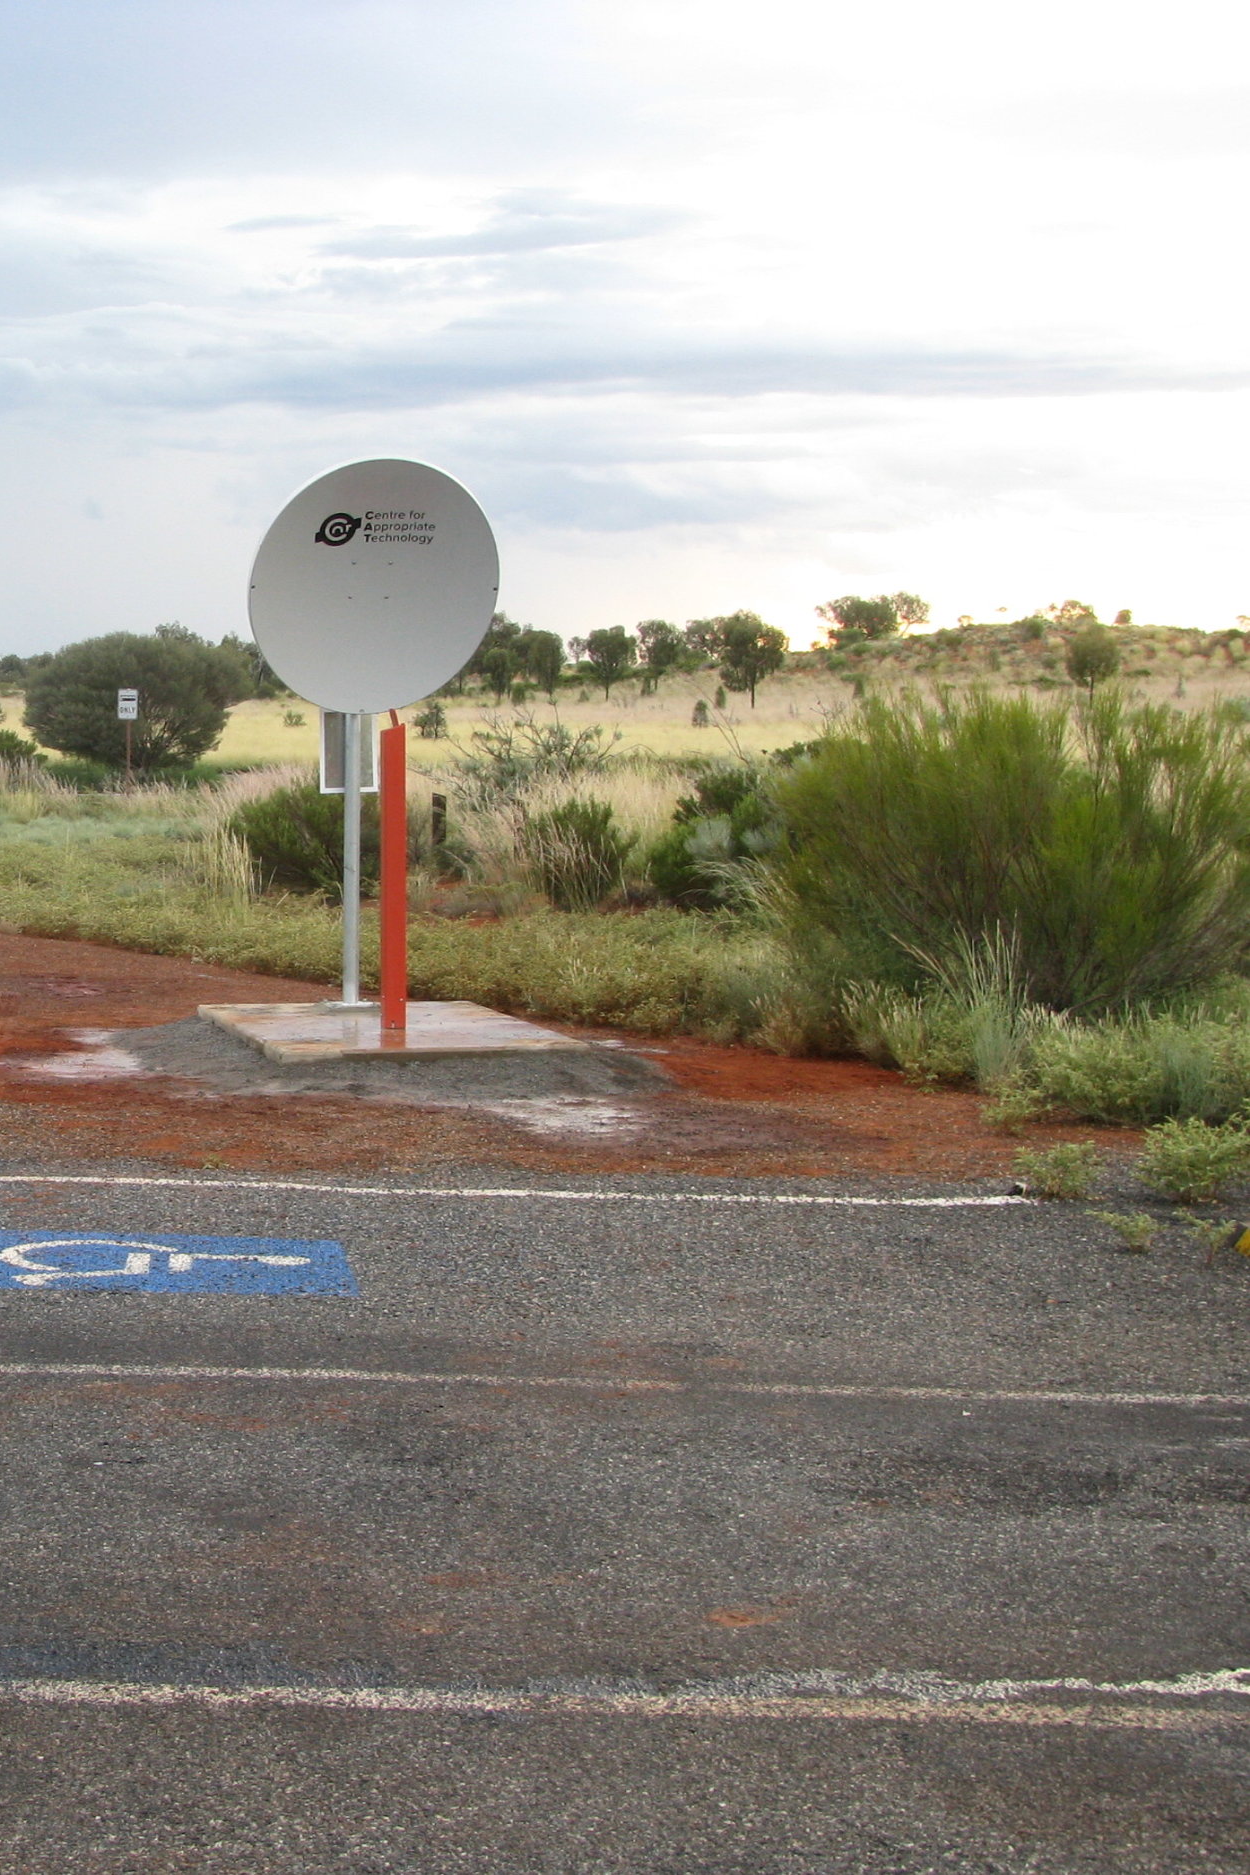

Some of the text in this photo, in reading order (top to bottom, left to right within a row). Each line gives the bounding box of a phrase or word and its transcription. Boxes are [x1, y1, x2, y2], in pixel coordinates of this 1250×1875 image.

[365, 510, 426, 520] Centre for
[363, 522, 436, 533] Appropriate
[363, 533, 434, 544] Technology
